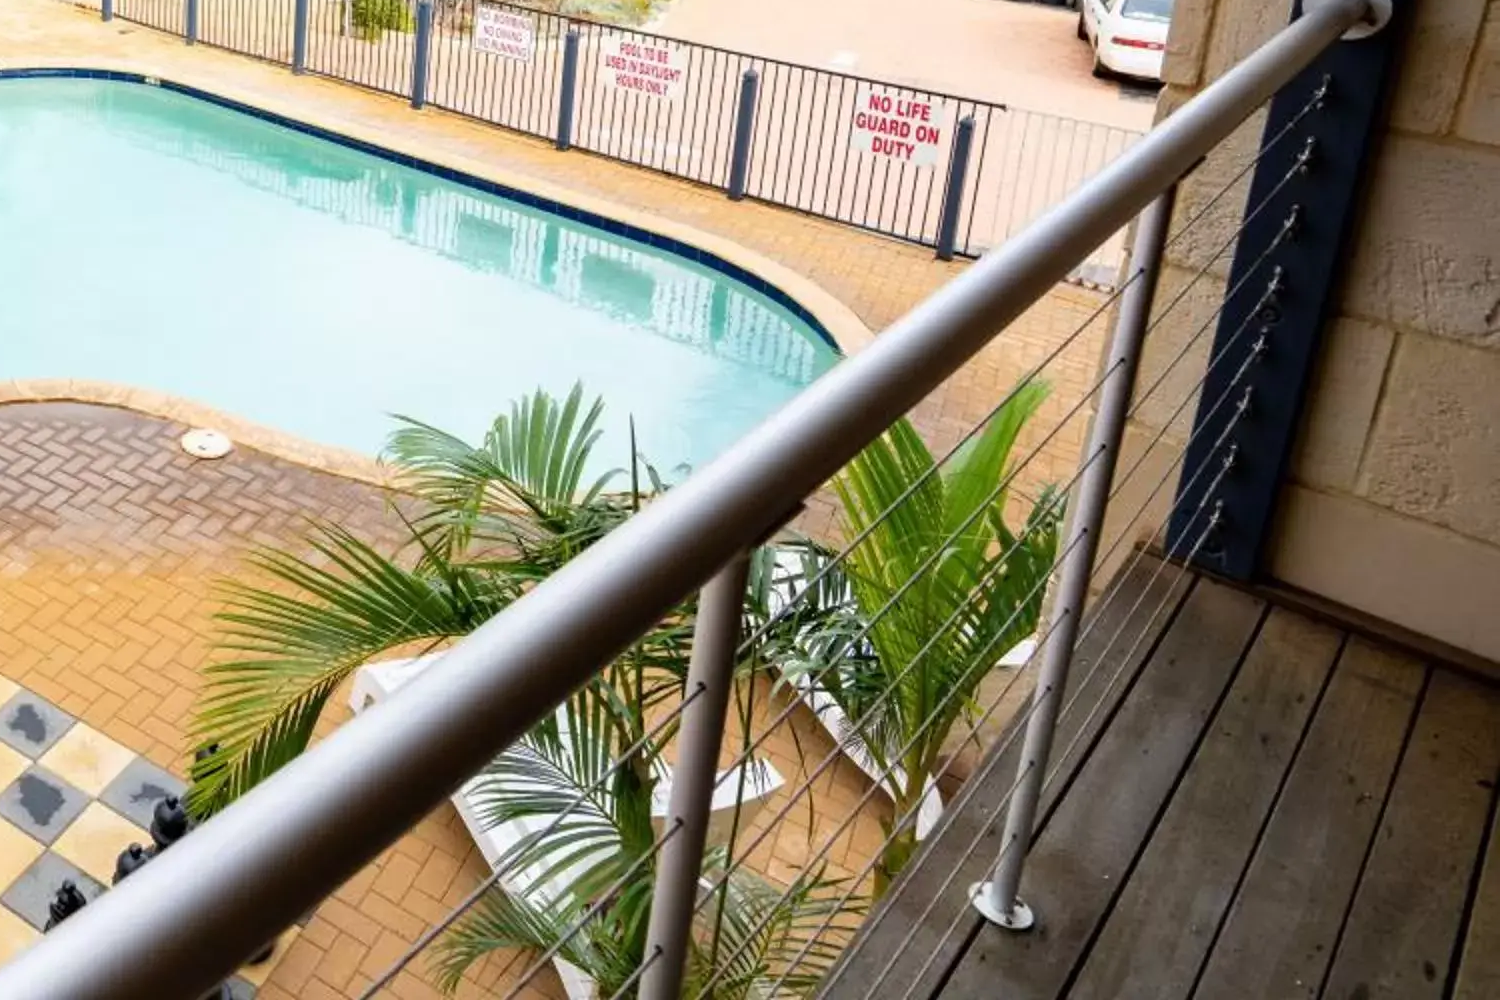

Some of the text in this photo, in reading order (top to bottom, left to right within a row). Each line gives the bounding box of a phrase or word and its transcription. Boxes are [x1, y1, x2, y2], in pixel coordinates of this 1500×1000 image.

[620, 42, 668, 65] POOL TO BE
[605, 54, 682, 83] USED IN DAYLIGHT
[615, 73, 668, 96] HOURS ONLY
[869, 94, 931, 122] NO LIFE
[856, 112, 940, 145] GUARD ON
[872, 136, 915, 160] DUTY
